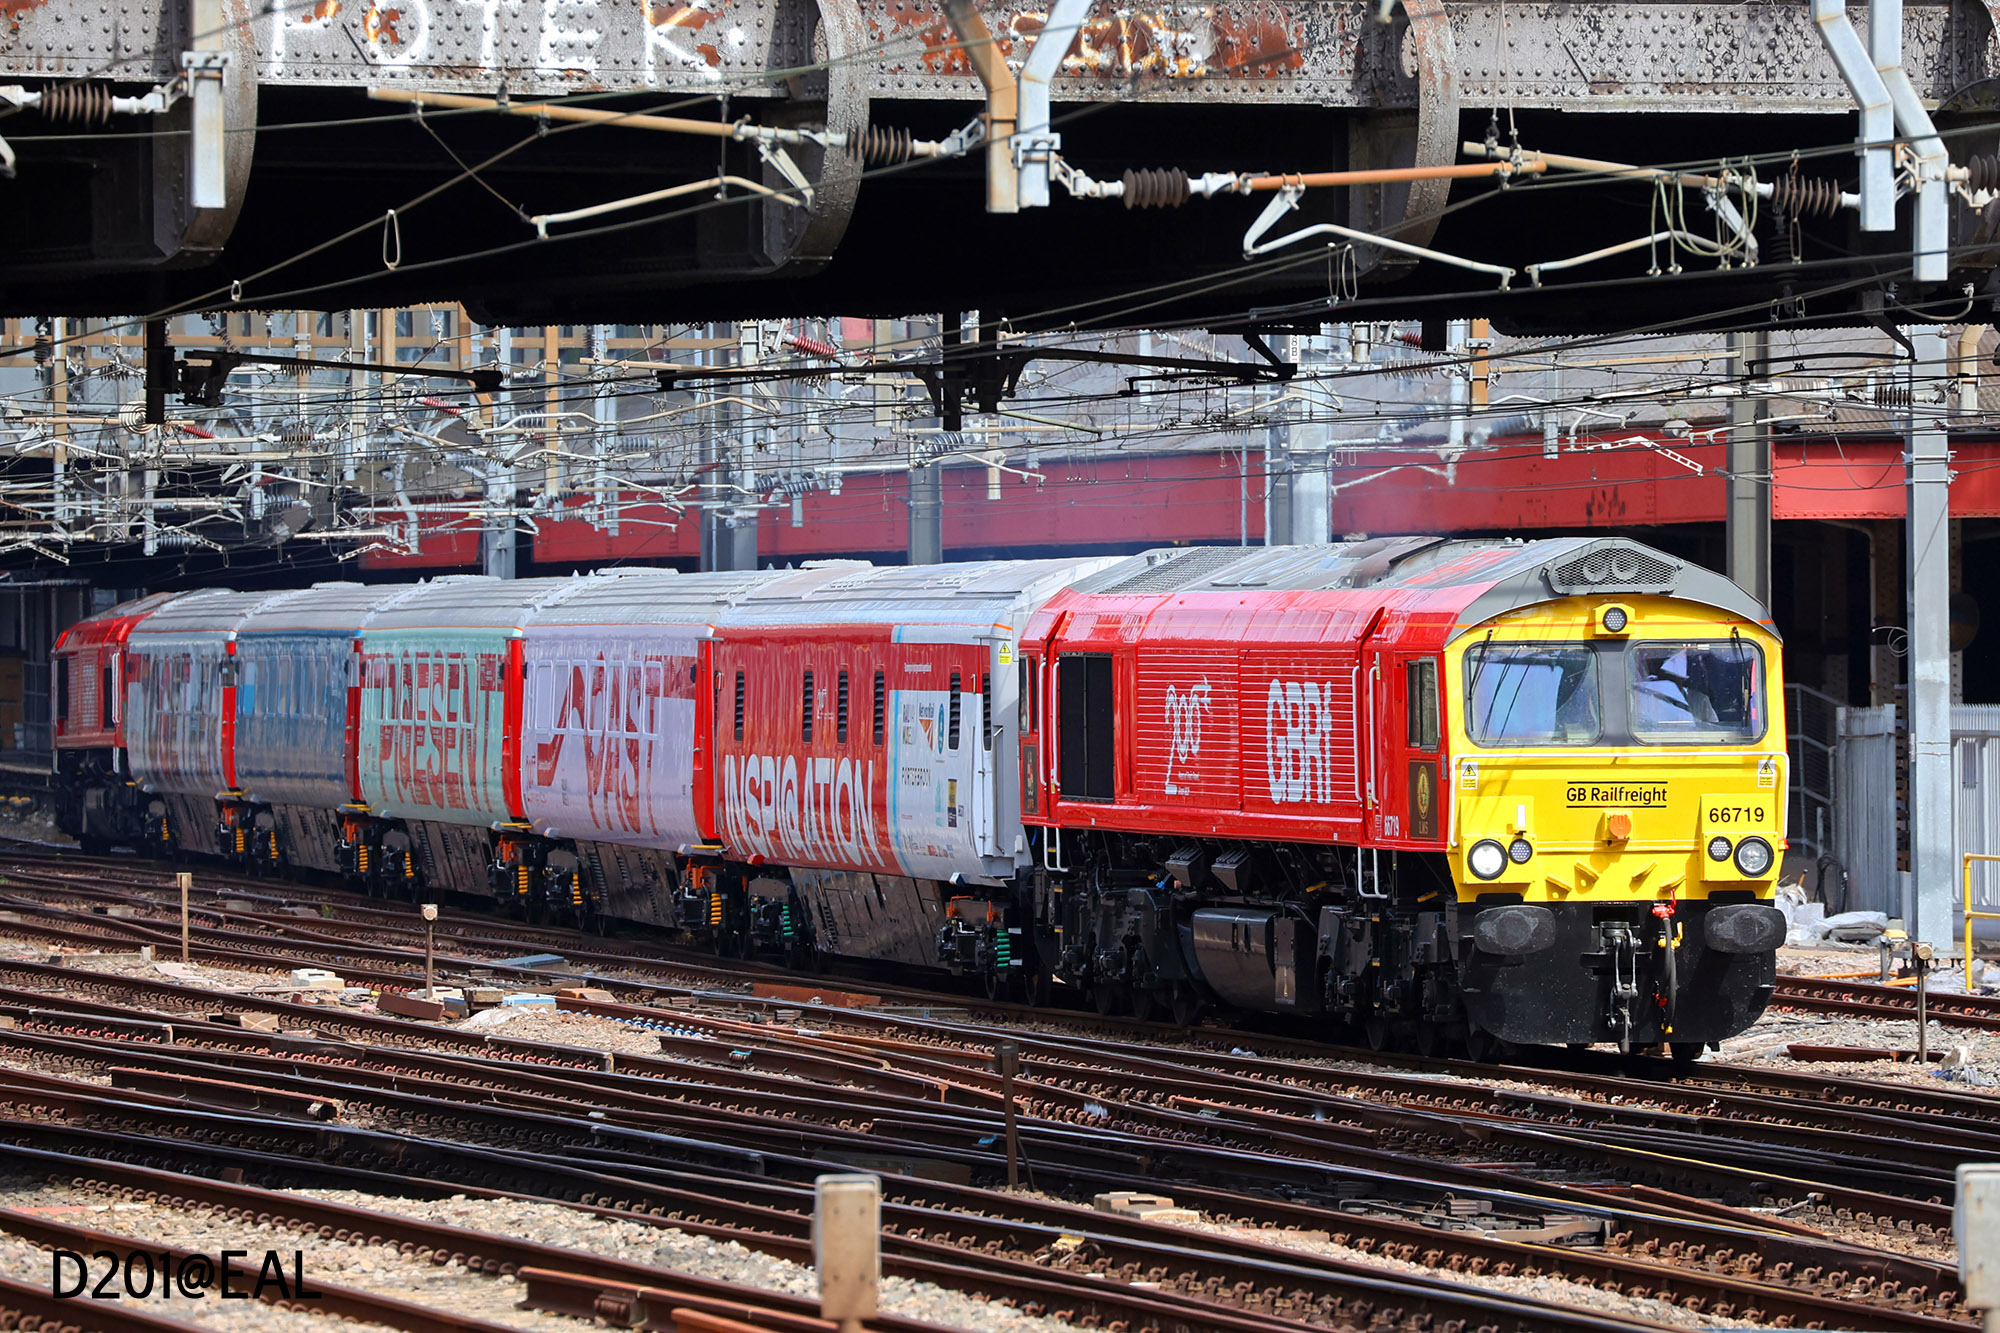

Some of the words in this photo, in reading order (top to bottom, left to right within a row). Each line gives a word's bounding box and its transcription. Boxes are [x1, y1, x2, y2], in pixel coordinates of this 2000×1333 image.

[1266, 679, 1332, 804] GBRf
[1566, 787, 1587, 802] GB
[1591, 786, 1668, 805] Railfreight
[725, 754, 885, 867] INSPIRATION
[1709, 807, 1764, 823] 66719
[1384, 815, 1400, 837] 66719
